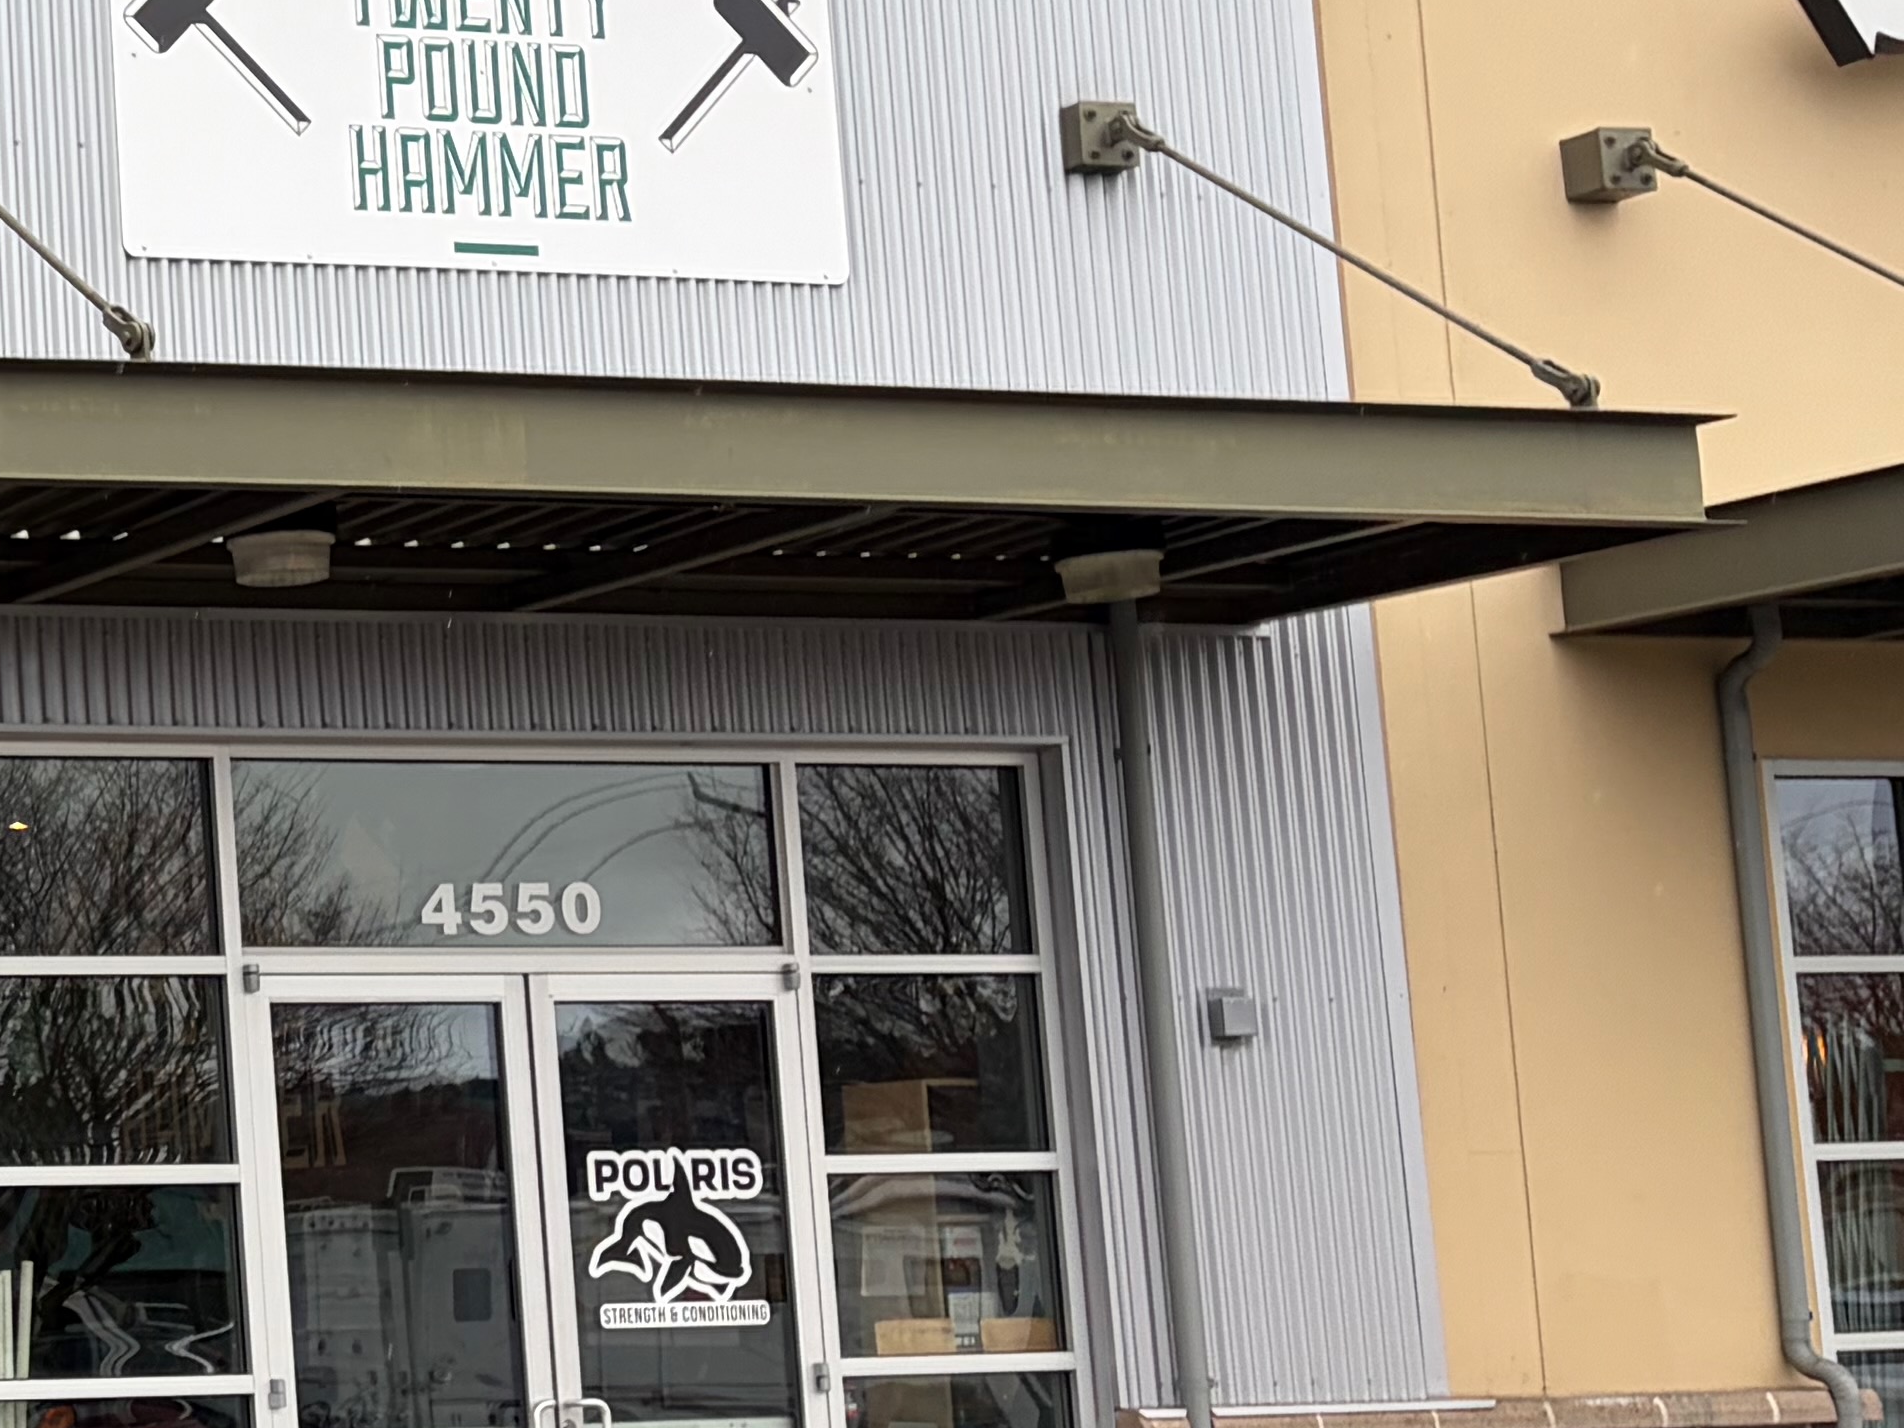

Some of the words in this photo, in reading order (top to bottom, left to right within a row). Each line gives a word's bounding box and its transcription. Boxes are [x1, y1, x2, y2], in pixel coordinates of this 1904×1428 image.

[377, 33, 590, 129] POUND
[348, 124, 632, 223] HAMMER
[421, 881, 601, 935] 4550
[603, 1306, 666, 1325] STRENGTH
[670, 1306, 678, 1323] &
[682, 1303, 768, 1323] CONDITIONING
